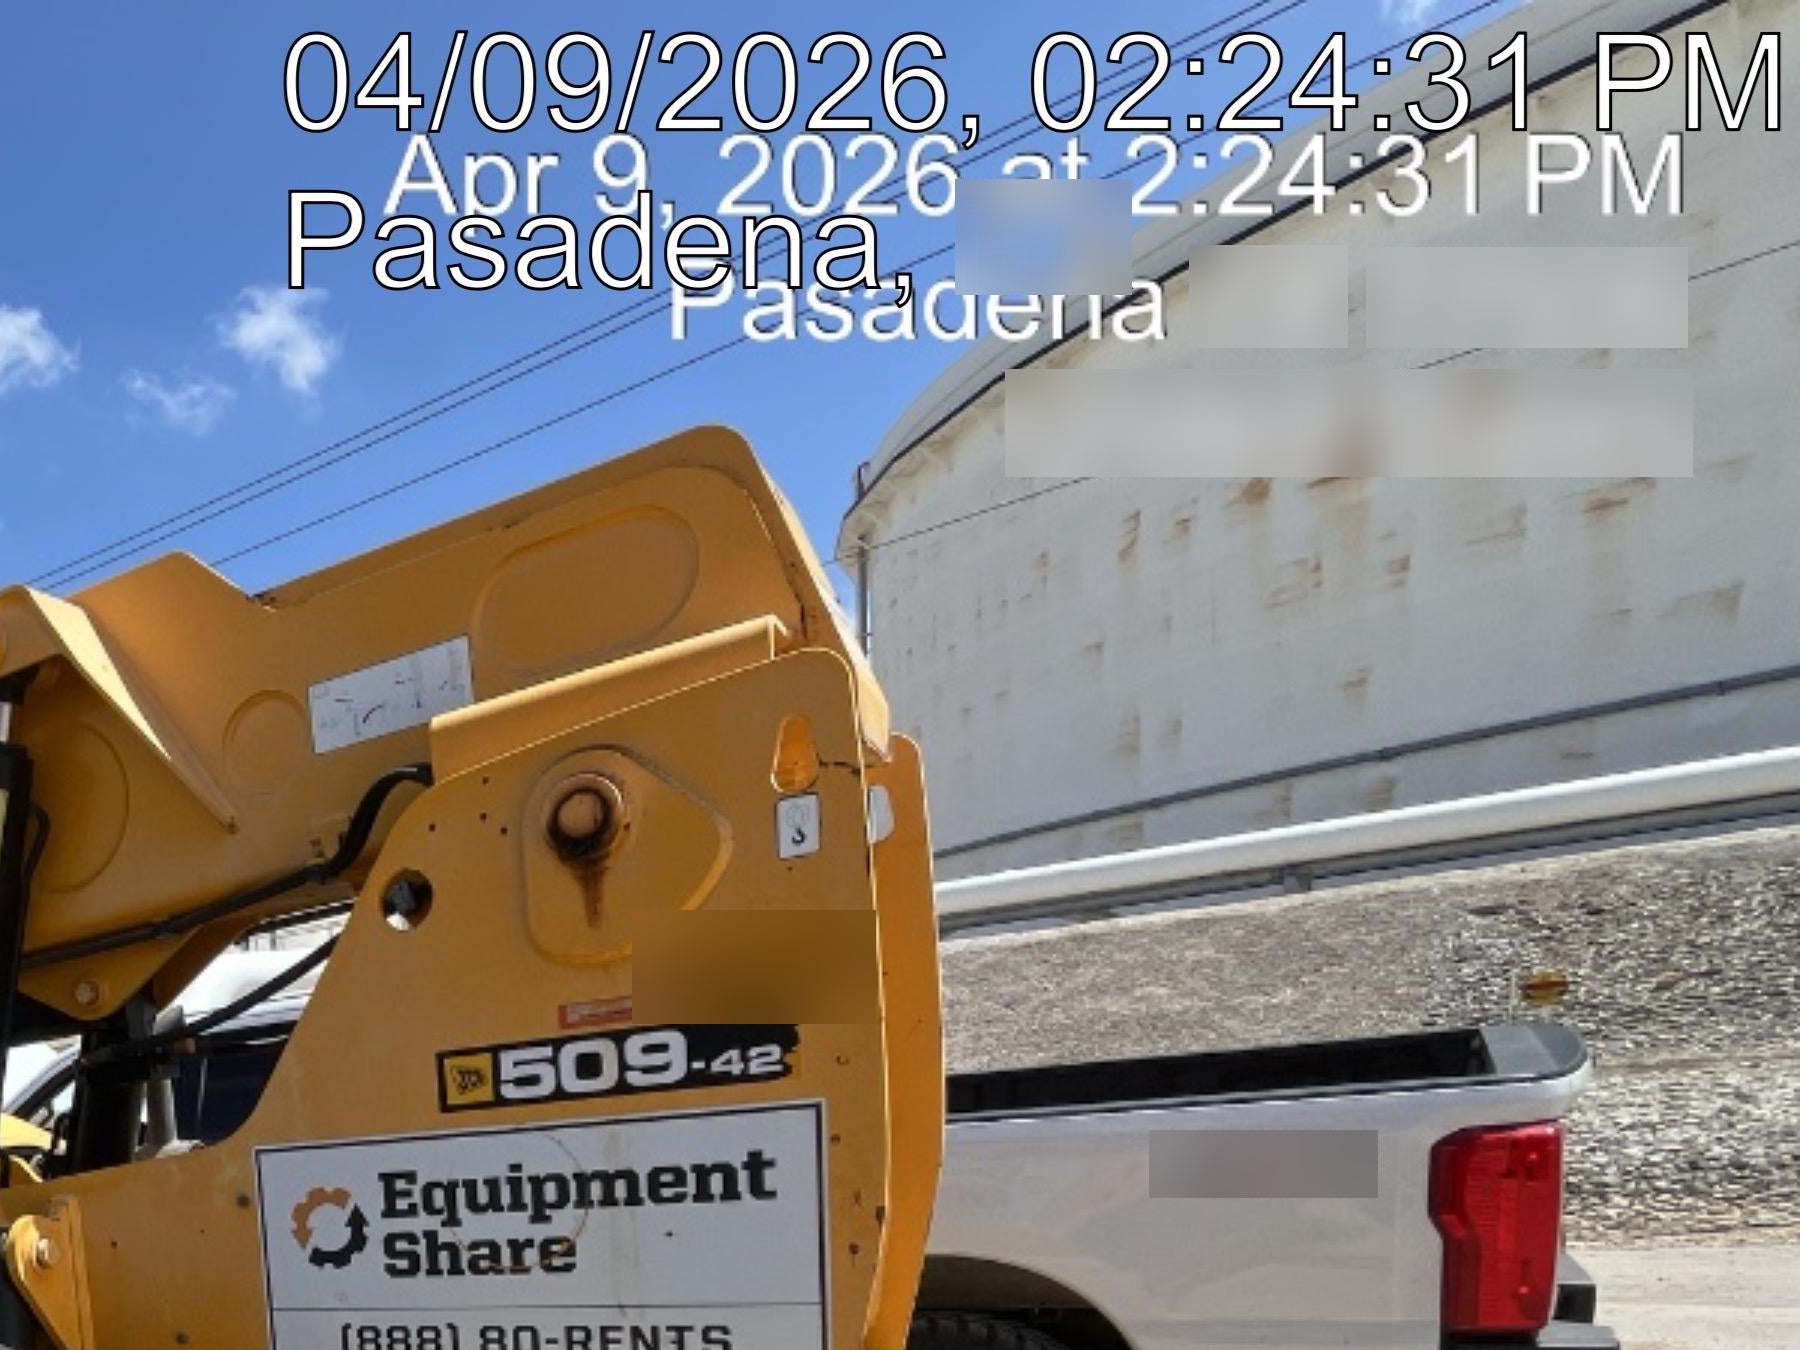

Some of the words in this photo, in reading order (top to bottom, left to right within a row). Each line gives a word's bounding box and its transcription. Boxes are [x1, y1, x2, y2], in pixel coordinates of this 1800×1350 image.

[500, 1030, 784, 1099] 509-42
[378, 1148, 777, 1228] Equipment
[382, 1230, 578, 1278] Share
